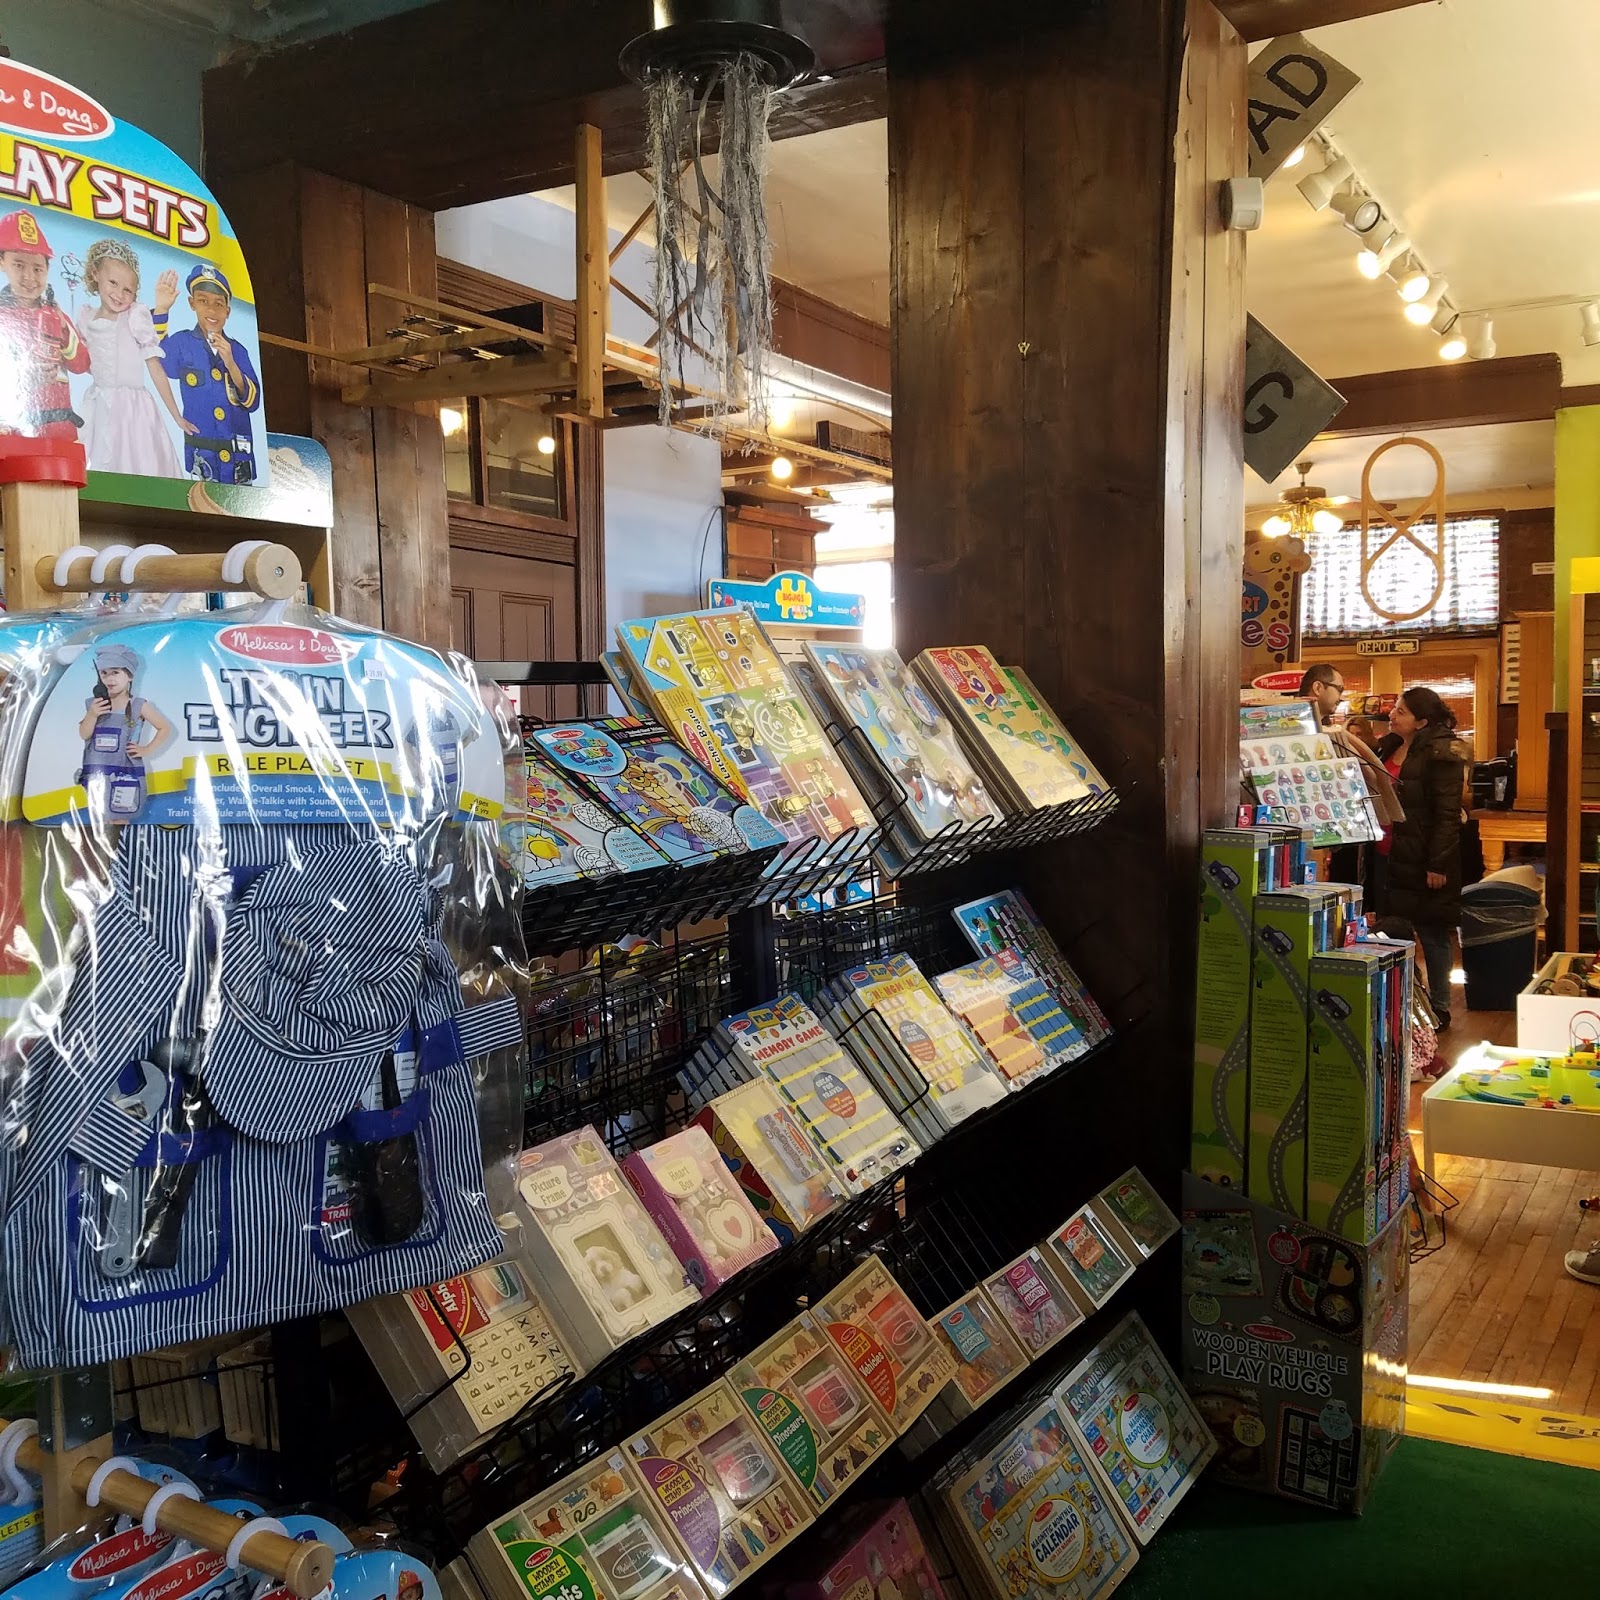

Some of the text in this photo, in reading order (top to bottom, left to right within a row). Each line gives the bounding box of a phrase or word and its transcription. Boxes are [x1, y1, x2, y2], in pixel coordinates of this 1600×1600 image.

[40, 91, 93, 133] Doug
[87, 165, 210, 248] SETS
[231, 629, 348, 661] Melissa & Dou
[1358, 641, 1391, 653] DEPOT
[220, 668, 346, 713] TRIN
[184, 703, 394, 749] ENGIEER
[685, 707, 732, 780] Latches Board
[217, 757, 267, 772] RLE
[276, 756, 321, 772] PLA
[207, 783, 371, 796] nclude Overall Smock, Wrech,
[228, 796, 285, 806] Walie-Talkie
[287, 796, 307, 806] with
[310, 797, 335, 807] Sound
[339, 797, 366, 807] ffect
[369, 798, 384, 807] and
[167, 807, 190, 818] Train
[235, 807, 251, 818] and
[255, 807, 282, 818] Name
[284, 807, 299, 820] Tag
[300, 807, 314, 818] for
[316, 808, 340, 818] Pencil
[341, 808, 402, 819] ersonlization!
[753, 1011, 774, 1024] FLIP
[755, 1025, 824, 1060] MEMORY GAME
[822, 1086, 843, 1100] TRAVEL
[530, 1176, 562, 1195] Picture
[668, 1166, 691, 1182] Heart
[678, 1179, 696, 1192] Box
[540, 1189, 568, 1207] Frame
[327, 1208, 352, 1221] TRAI
[657, 1213, 678, 1243] WOODEN
[859, 1351, 885, 1377] Vehicles
[1193, 1328, 1348, 1375] WOODEN VEHICLE
[1070, 1348, 1120, 1412] Responsibility
[1207, 1353, 1333, 1397] PLAY RUGS
[766, 1406, 790, 1430] STAMP SET
[772, 1415, 806, 1446] Dinosaurs
[1140, 1422, 1157, 1444] CHART
[1001, 1445, 1026, 1473] DECEMBER
[662, 1474, 686, 1494] WOODEN
[1020, 1468, 1034, 1486] 2018
[664, 1480, 693, 1505] STAMP SET
[670, 1490, 710, 1522] Princesses
[1, 1518, 31, 1538] LET'S
[1030, 1524, 1054, 1551] MAGNETIC
[1035, 1513, 1081, 1563] CALENDAR
[80, 1531, 173, 1575] Melissa & Doug
[127, 1578, 182, 1600] Melissa
[186, 1567, 194, 1580] &
[197, 1553, 227, 1577] Doug
[531, 1558, 561, 1582] WOODEN
[533, 1565, 570, 1594] STAMP SET
